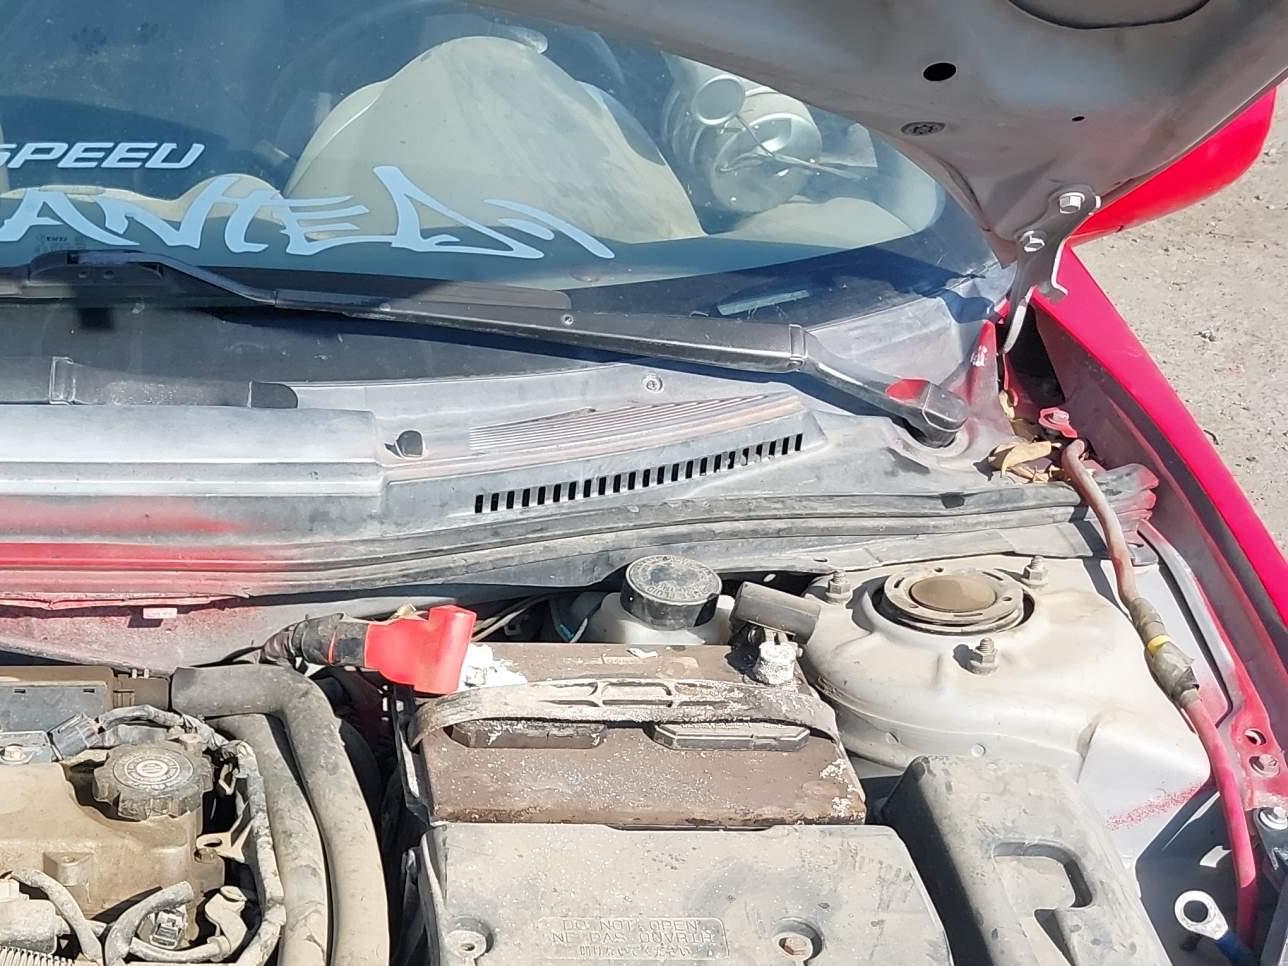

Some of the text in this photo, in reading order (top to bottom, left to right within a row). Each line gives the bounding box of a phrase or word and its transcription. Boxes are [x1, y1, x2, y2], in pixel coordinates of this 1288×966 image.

[562, 919, 699, 931] DO NOT OPEN
[551, 931, 576, 944] NE
